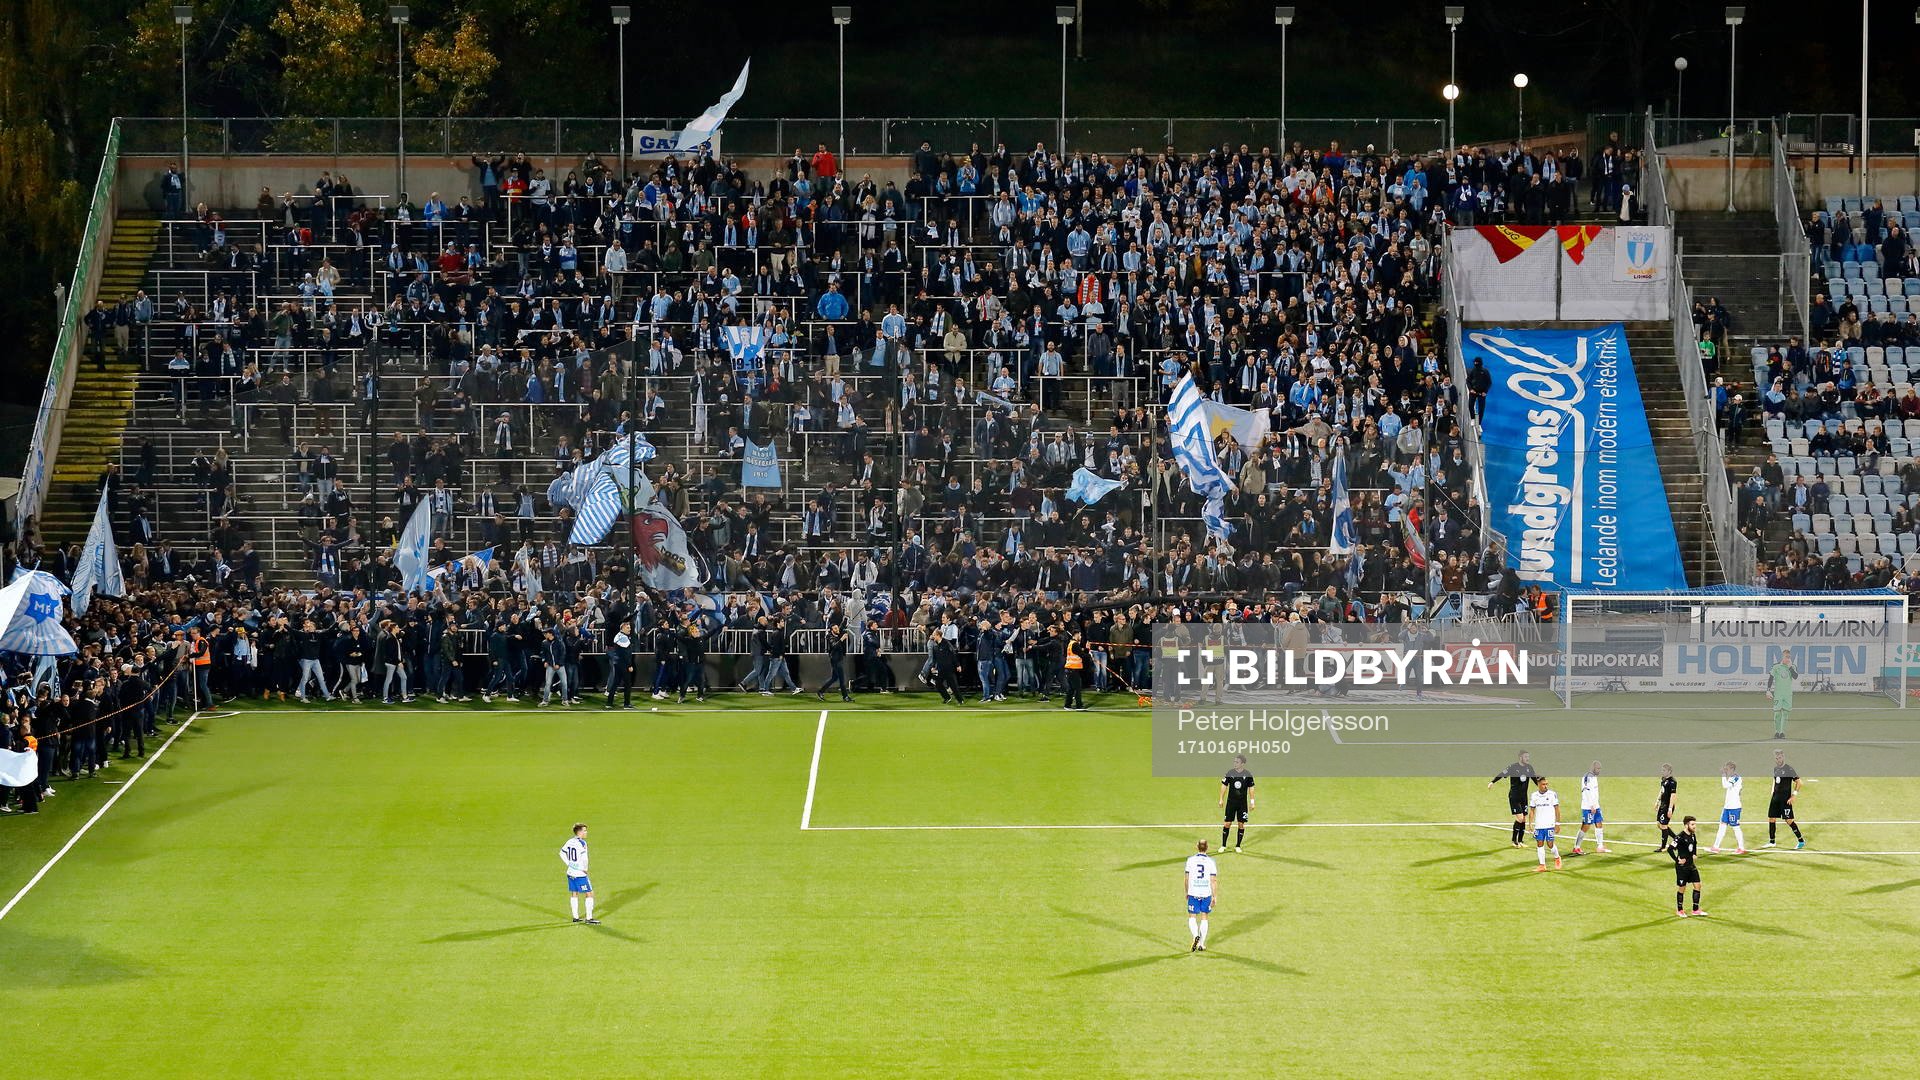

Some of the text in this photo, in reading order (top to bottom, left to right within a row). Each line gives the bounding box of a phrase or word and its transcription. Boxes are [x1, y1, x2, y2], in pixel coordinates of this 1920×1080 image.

[1591, 335, 1618, 586] Ledande inom modern elteknik
[1711, 612, 1889, 638] KULTURMÅLARNA
[1517, 653, 1659, 667] INDUSTRIPORTAR
[1677, 644, 1867, 675] HOLMEN
[567, 846, 578, 862] 10
[1196, 864, 1205, 879] 3
